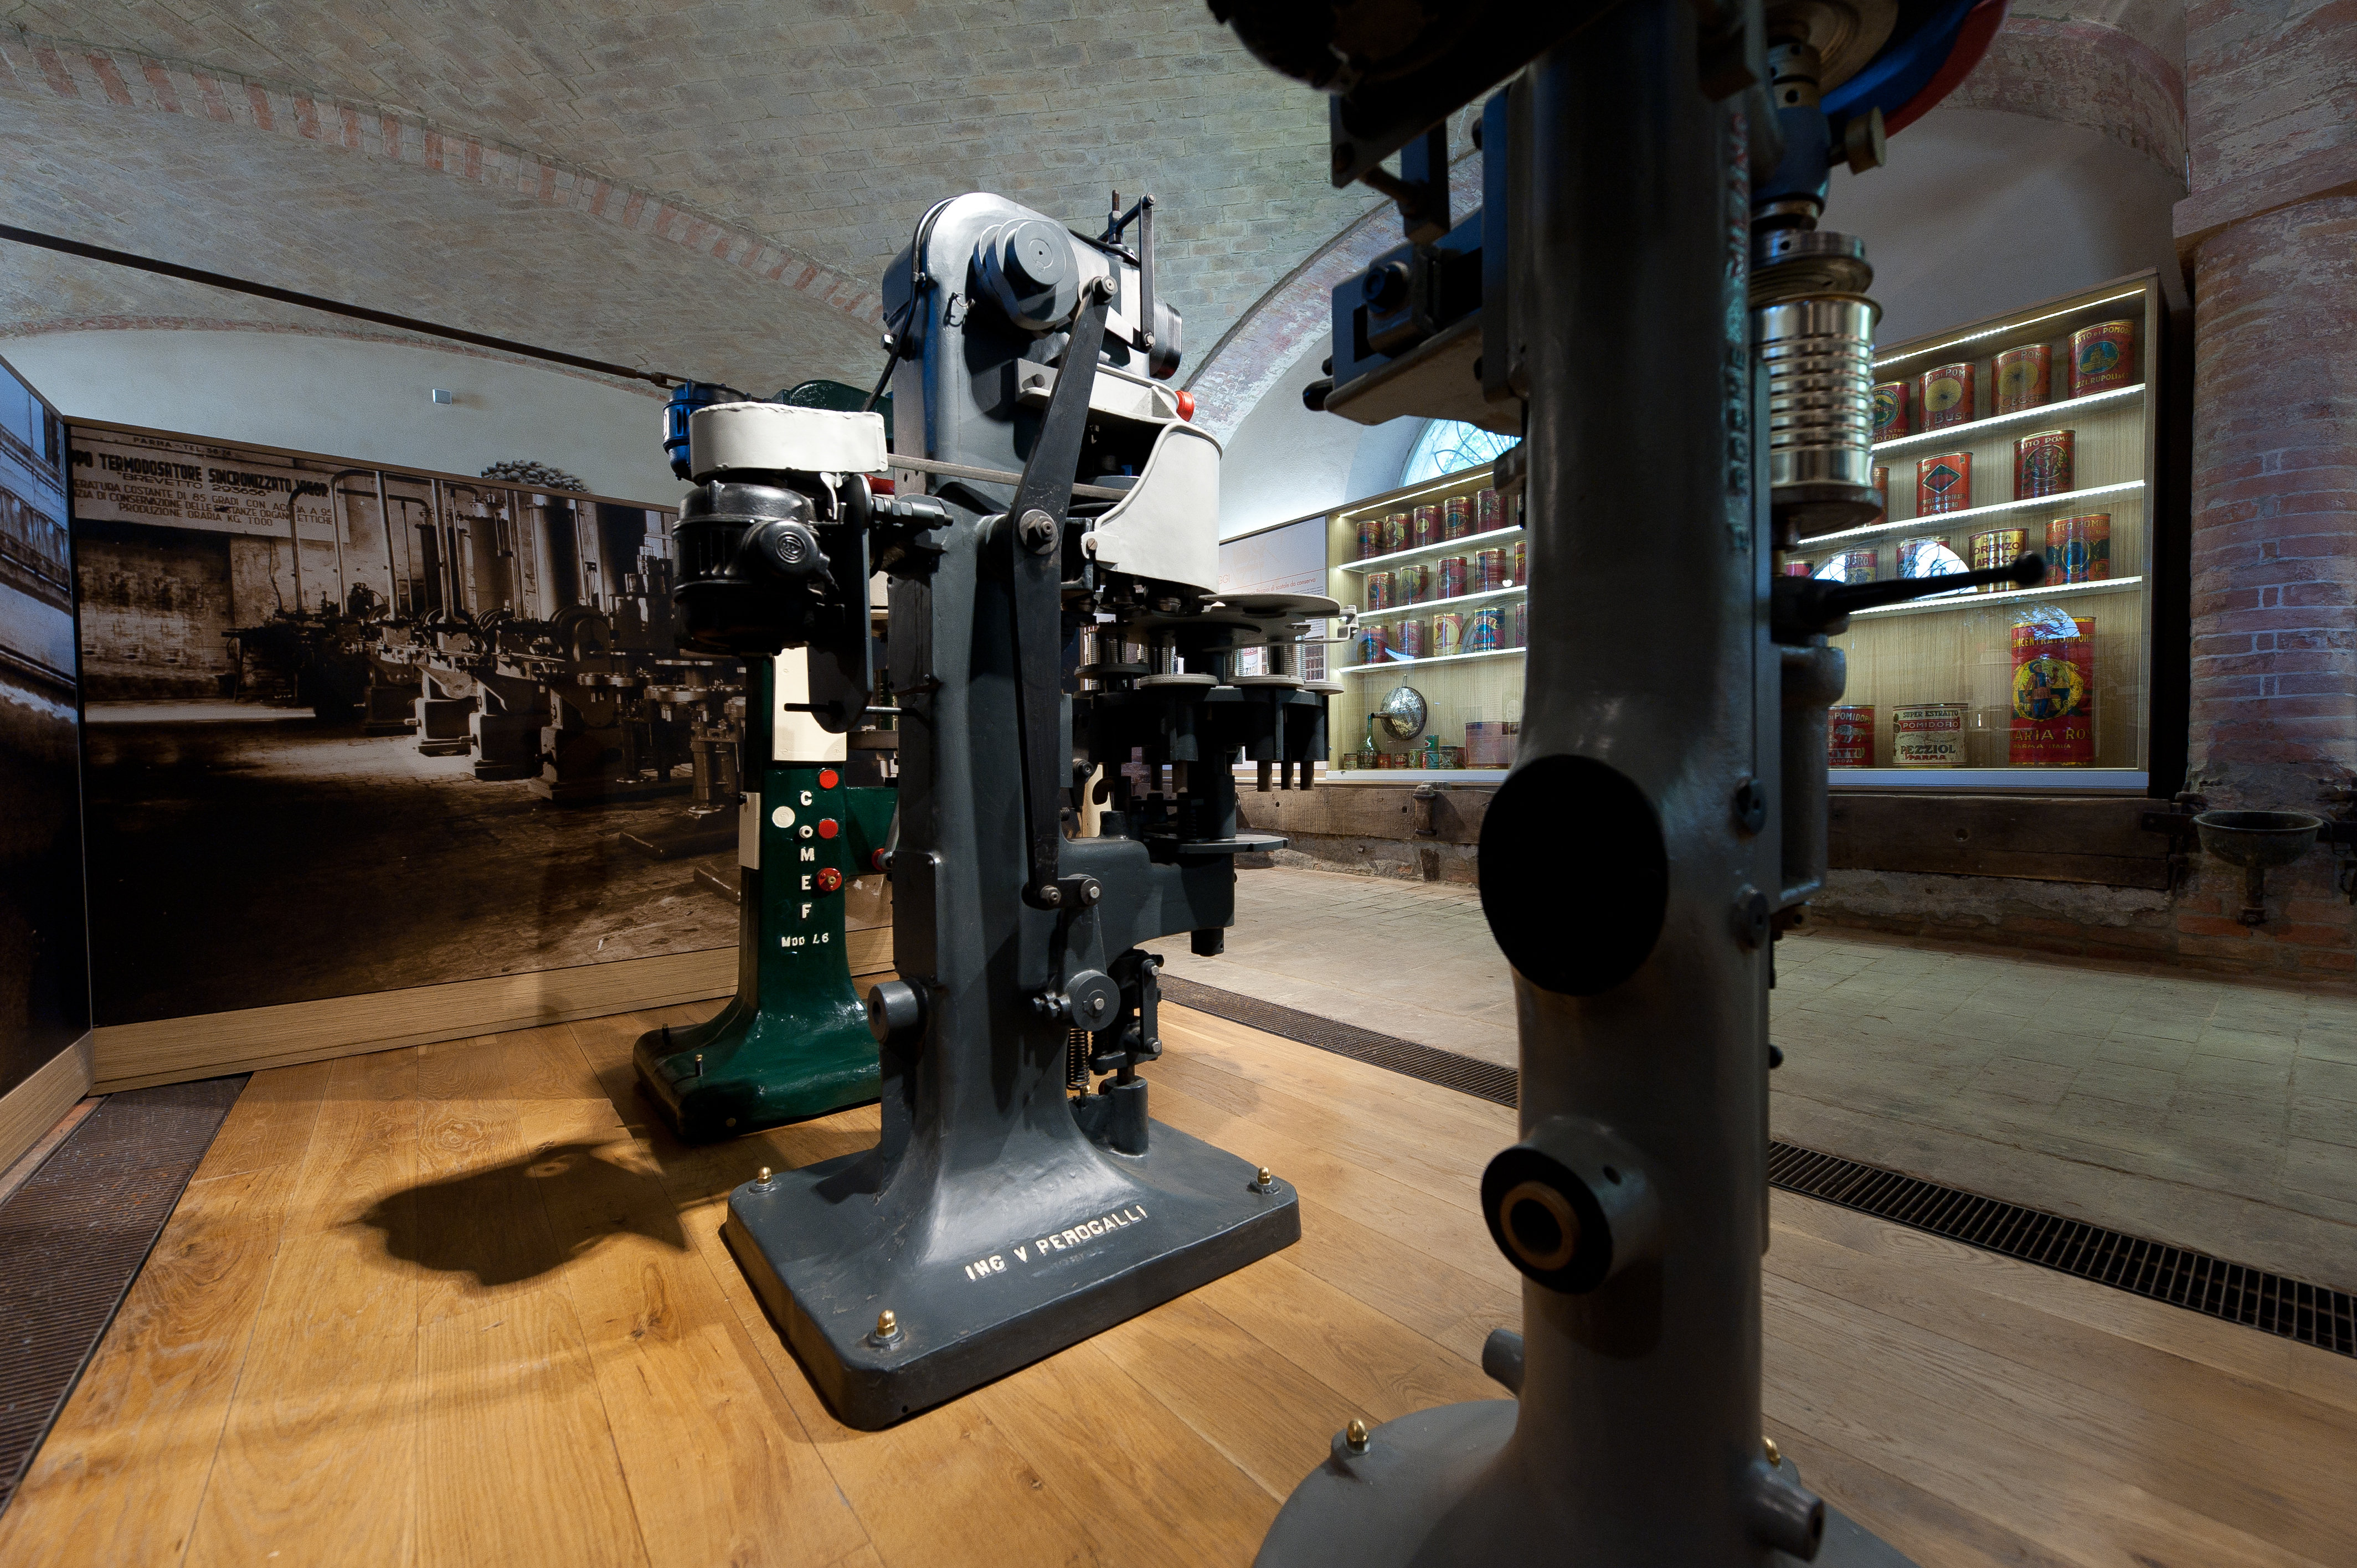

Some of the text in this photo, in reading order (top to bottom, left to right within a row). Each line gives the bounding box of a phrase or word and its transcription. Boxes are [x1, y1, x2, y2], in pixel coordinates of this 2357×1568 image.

[133, 437, 172, 448] PARMA
[99, 453, 203, 482] TERMODOSATORE
[208, 468, 292, 493] SINCRONIZZATO
[97, 491, 106, 500] DI
[110, 493, 182, 509] CONSERVAZIONE
[186, 501, 212, 512] DELLE
[260, 509, 333, 525] ORGANETTICHE
[124, 484, 173, 498] COSTANTE
[177, 491, 186, 501] DI
[193, 493, 206, 502] 85
[212, 495, 239, 506] GRADI
[246, 499, 266, 509] CON
[310, 507, 317, 515] A
[119, 503, 183, 518] PRODUZIONE
[187, 510, 223, 522] ORARIA
[1275, 582, 1289, 590] scatole
[1296, 577, 1316, 586] conserva
[1835, 712, 1871, 725] POMIDORO
[1900, 744, 1957, 755] PEZZIOL
[965, 1255, 1006, 1281] ING
[1013, 1246, 1028, 1263] V
